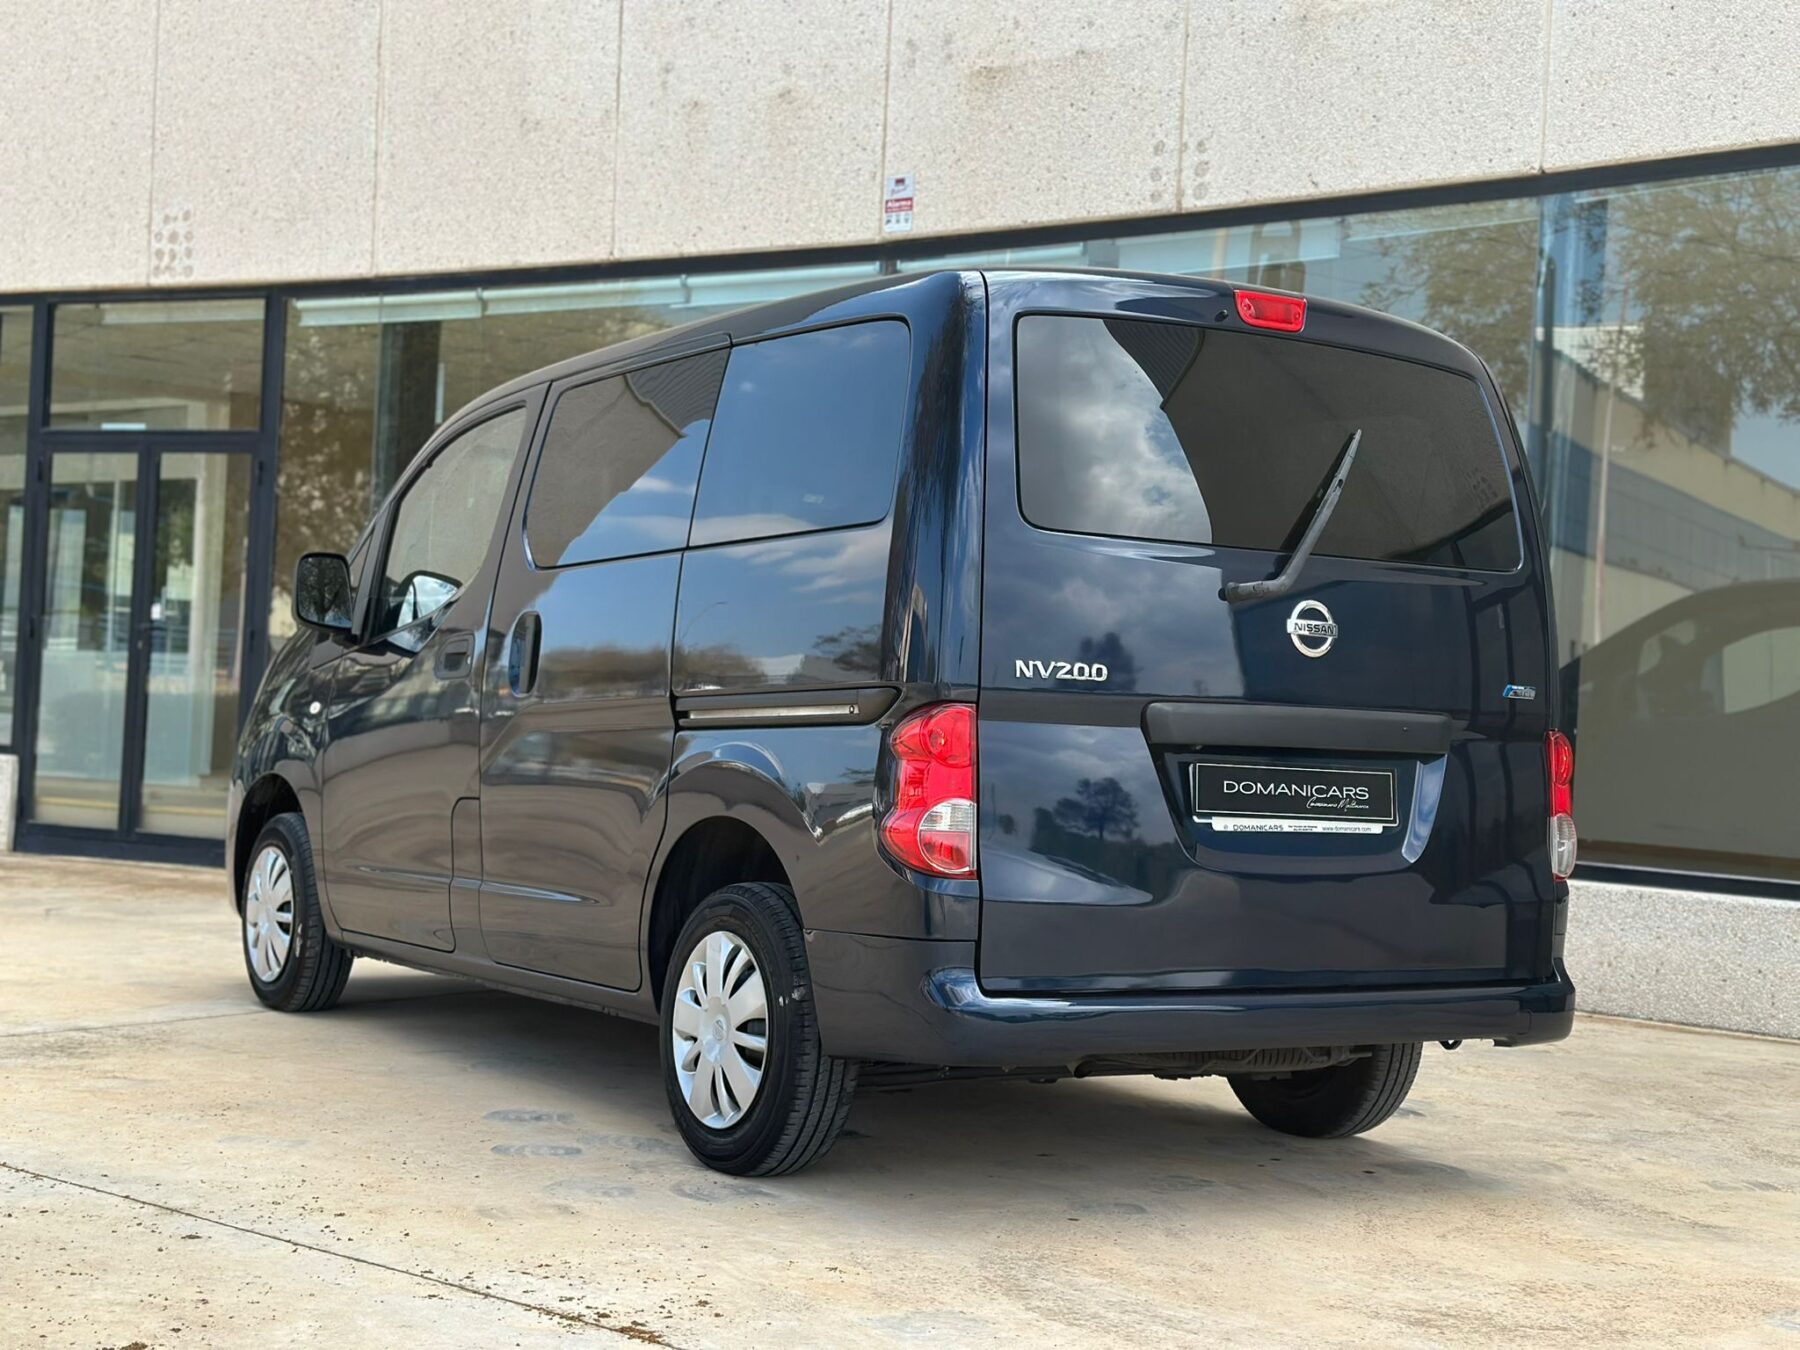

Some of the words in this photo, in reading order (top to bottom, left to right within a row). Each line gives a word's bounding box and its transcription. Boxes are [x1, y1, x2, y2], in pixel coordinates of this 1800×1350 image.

[1294, 622, 1336, 635] NISSAN
[1015, 659, 1108, 681] NV200
[1223, 780, 1369, 800] DOMANICARS
[1233, 824, 1284, 832] DOMANICARS
